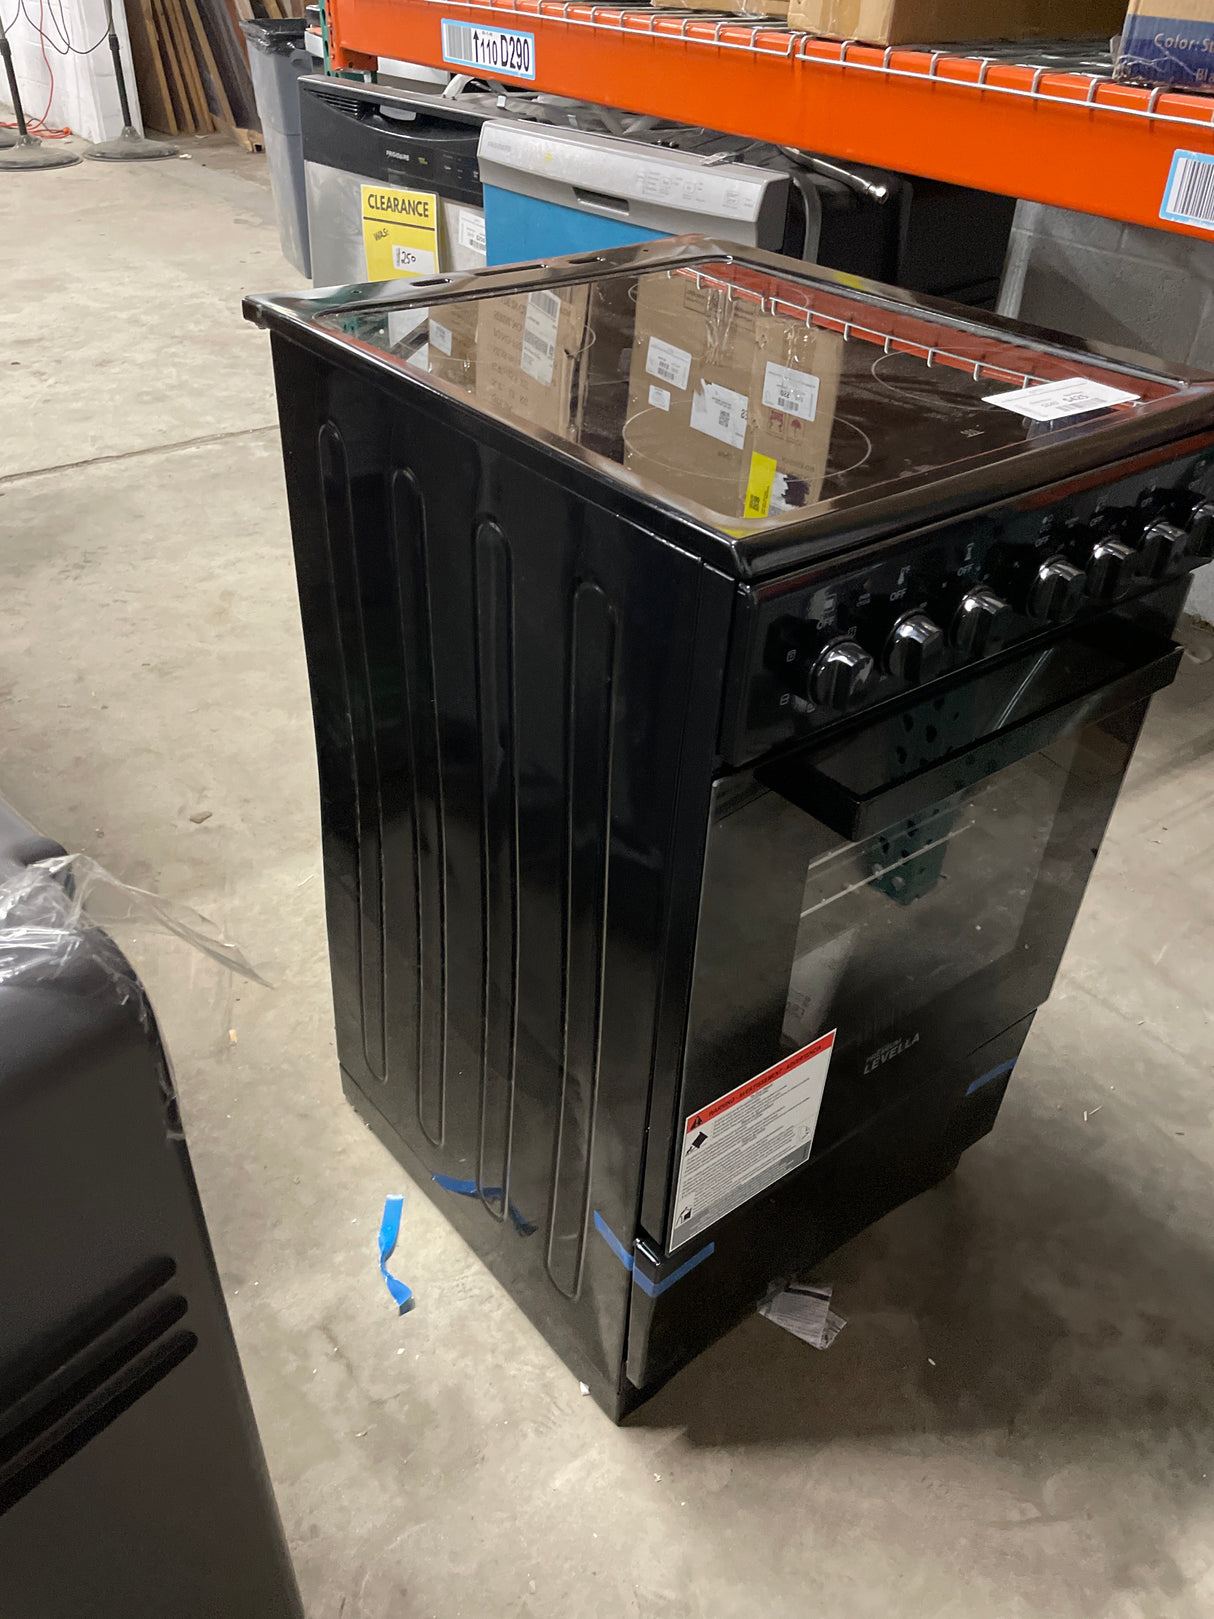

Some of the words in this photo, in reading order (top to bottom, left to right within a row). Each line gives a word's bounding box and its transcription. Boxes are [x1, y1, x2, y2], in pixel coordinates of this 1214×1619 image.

[481, 38, 498, 65] 110
[500, 34, 530, 72] D290
[367, 193, 429, 218] CLEARANCE
[889, 587, 907, 601] OFF
[863, 1032, 920, 1075] LEVELLA
